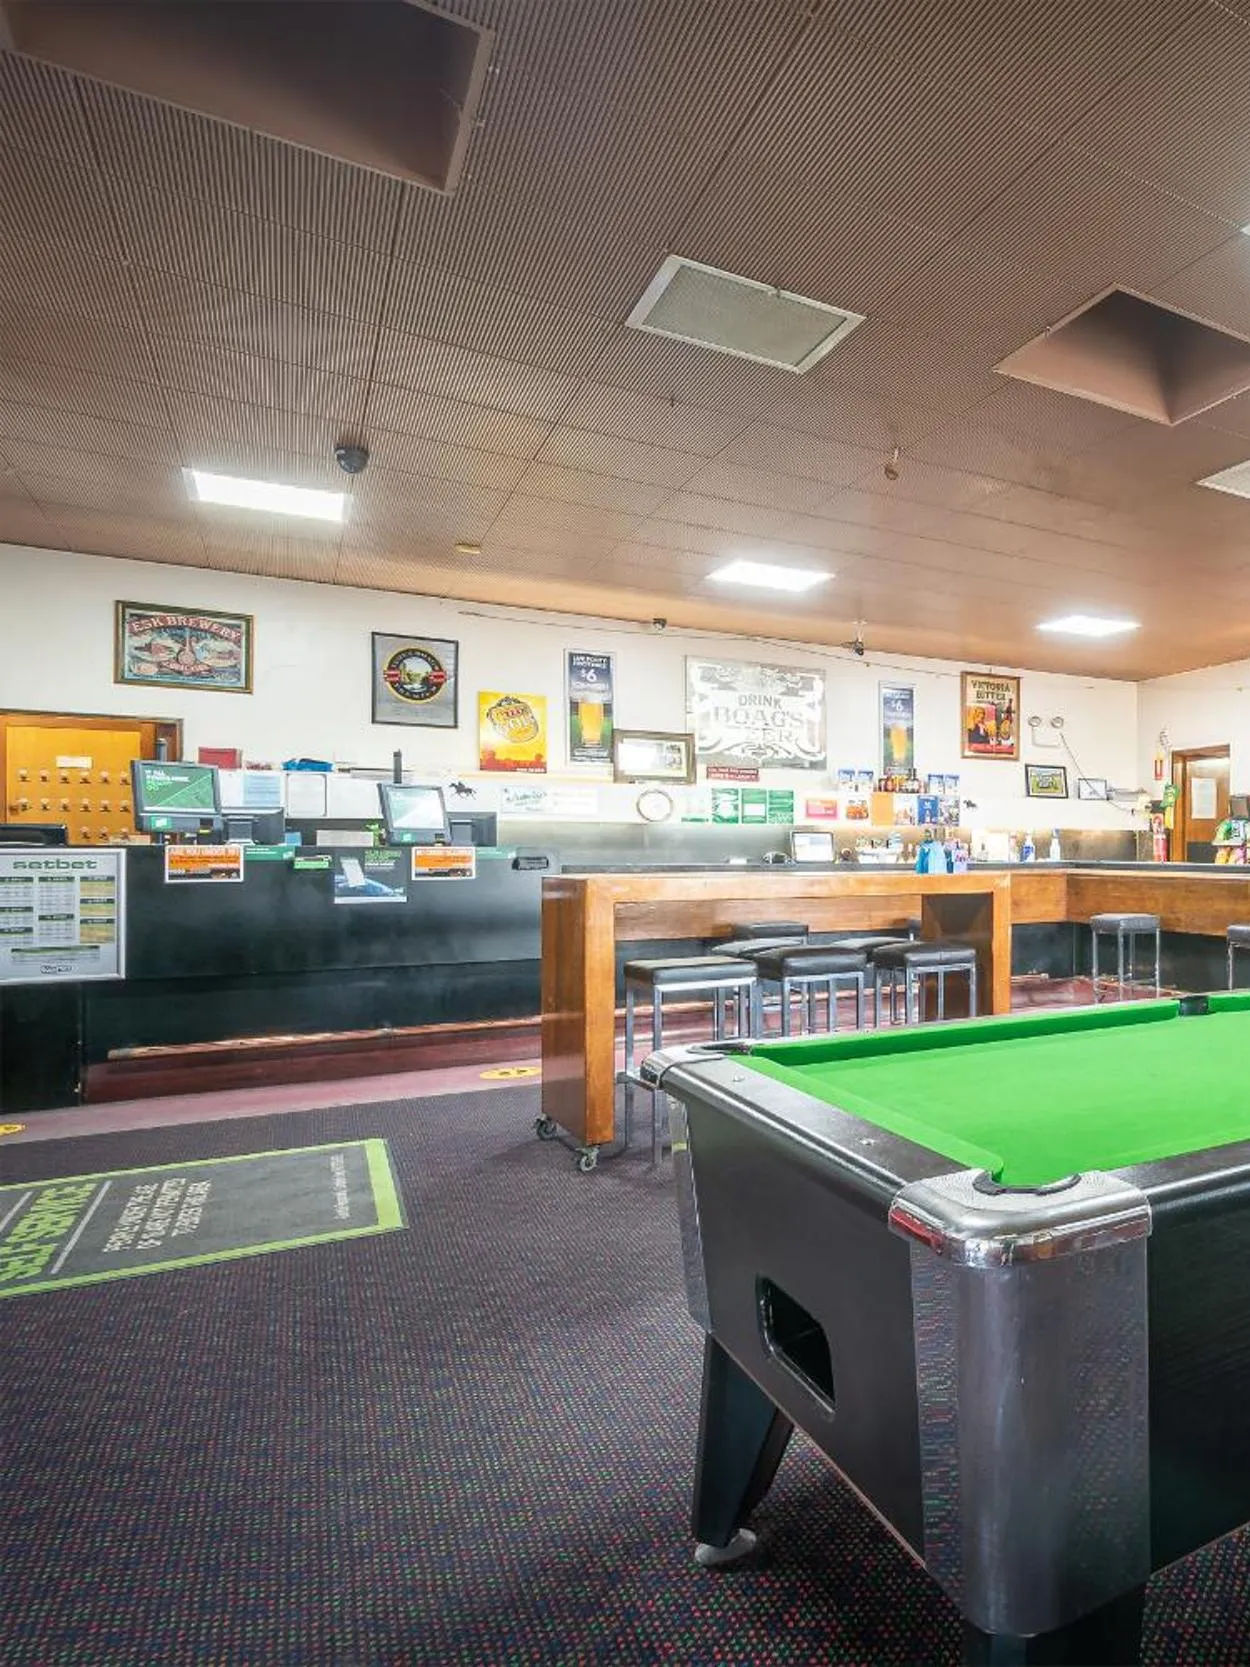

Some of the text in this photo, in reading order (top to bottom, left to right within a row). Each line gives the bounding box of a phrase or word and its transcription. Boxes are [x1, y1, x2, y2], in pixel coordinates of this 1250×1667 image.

[132, 615, 242, 640] ESK BREWERY
[738, 693, 782, 709] DRINK
